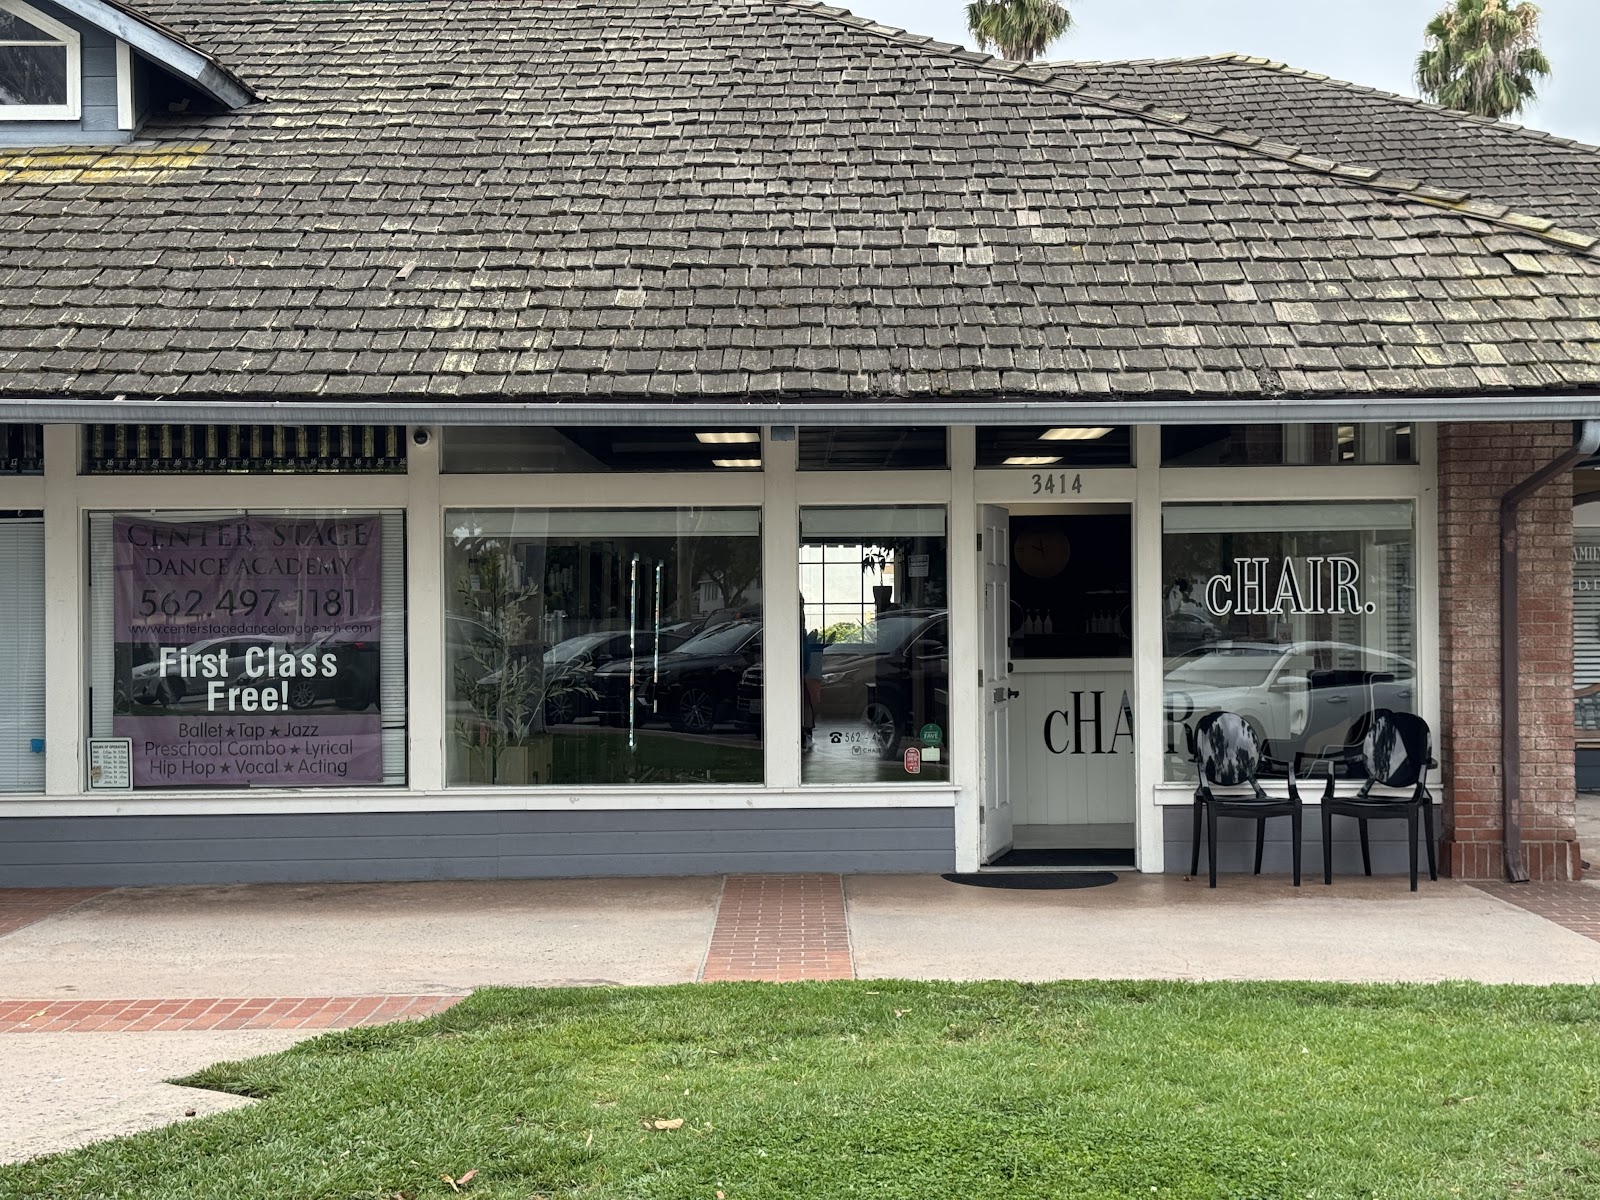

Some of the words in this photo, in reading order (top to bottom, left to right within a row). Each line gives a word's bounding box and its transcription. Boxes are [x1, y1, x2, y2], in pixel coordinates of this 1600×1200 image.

[1032, 473, 1083, 495] 3414
[127, 523, 253, 547] CENTER
[273, 522, 369, 547] STAGE
[145, 557, 229, 576] DANCE
[235, 557, 355, 576] ACADEMY
[138, 588, 356, 618] 562.497.1181
[128, 622, 372, 636] www.centerstagedancelongbeach.com
[159, 647, 228, 678] First
[245, 646, 338, 679] Class
[207, 681, 289, 712] Free!
[178, 723, 223, 738] Ballet
[237, 723, 265, 741] Tap
[284, 723, 319, 738] Jazz
[1043, 689, 1198, 755] cHAR
[844, 732, 860, 742] 562
[145, 740, 222, 757] Preschool
[227, 740, 286, 756] Combo
[305, 739, 353, 758] Lyrical
[150, 760, 177, 777] Hip
[182, 760, 216, 777] Hop
[234, 759, 278, 774] Vocal
[297, 759, 348, 776] Acting
